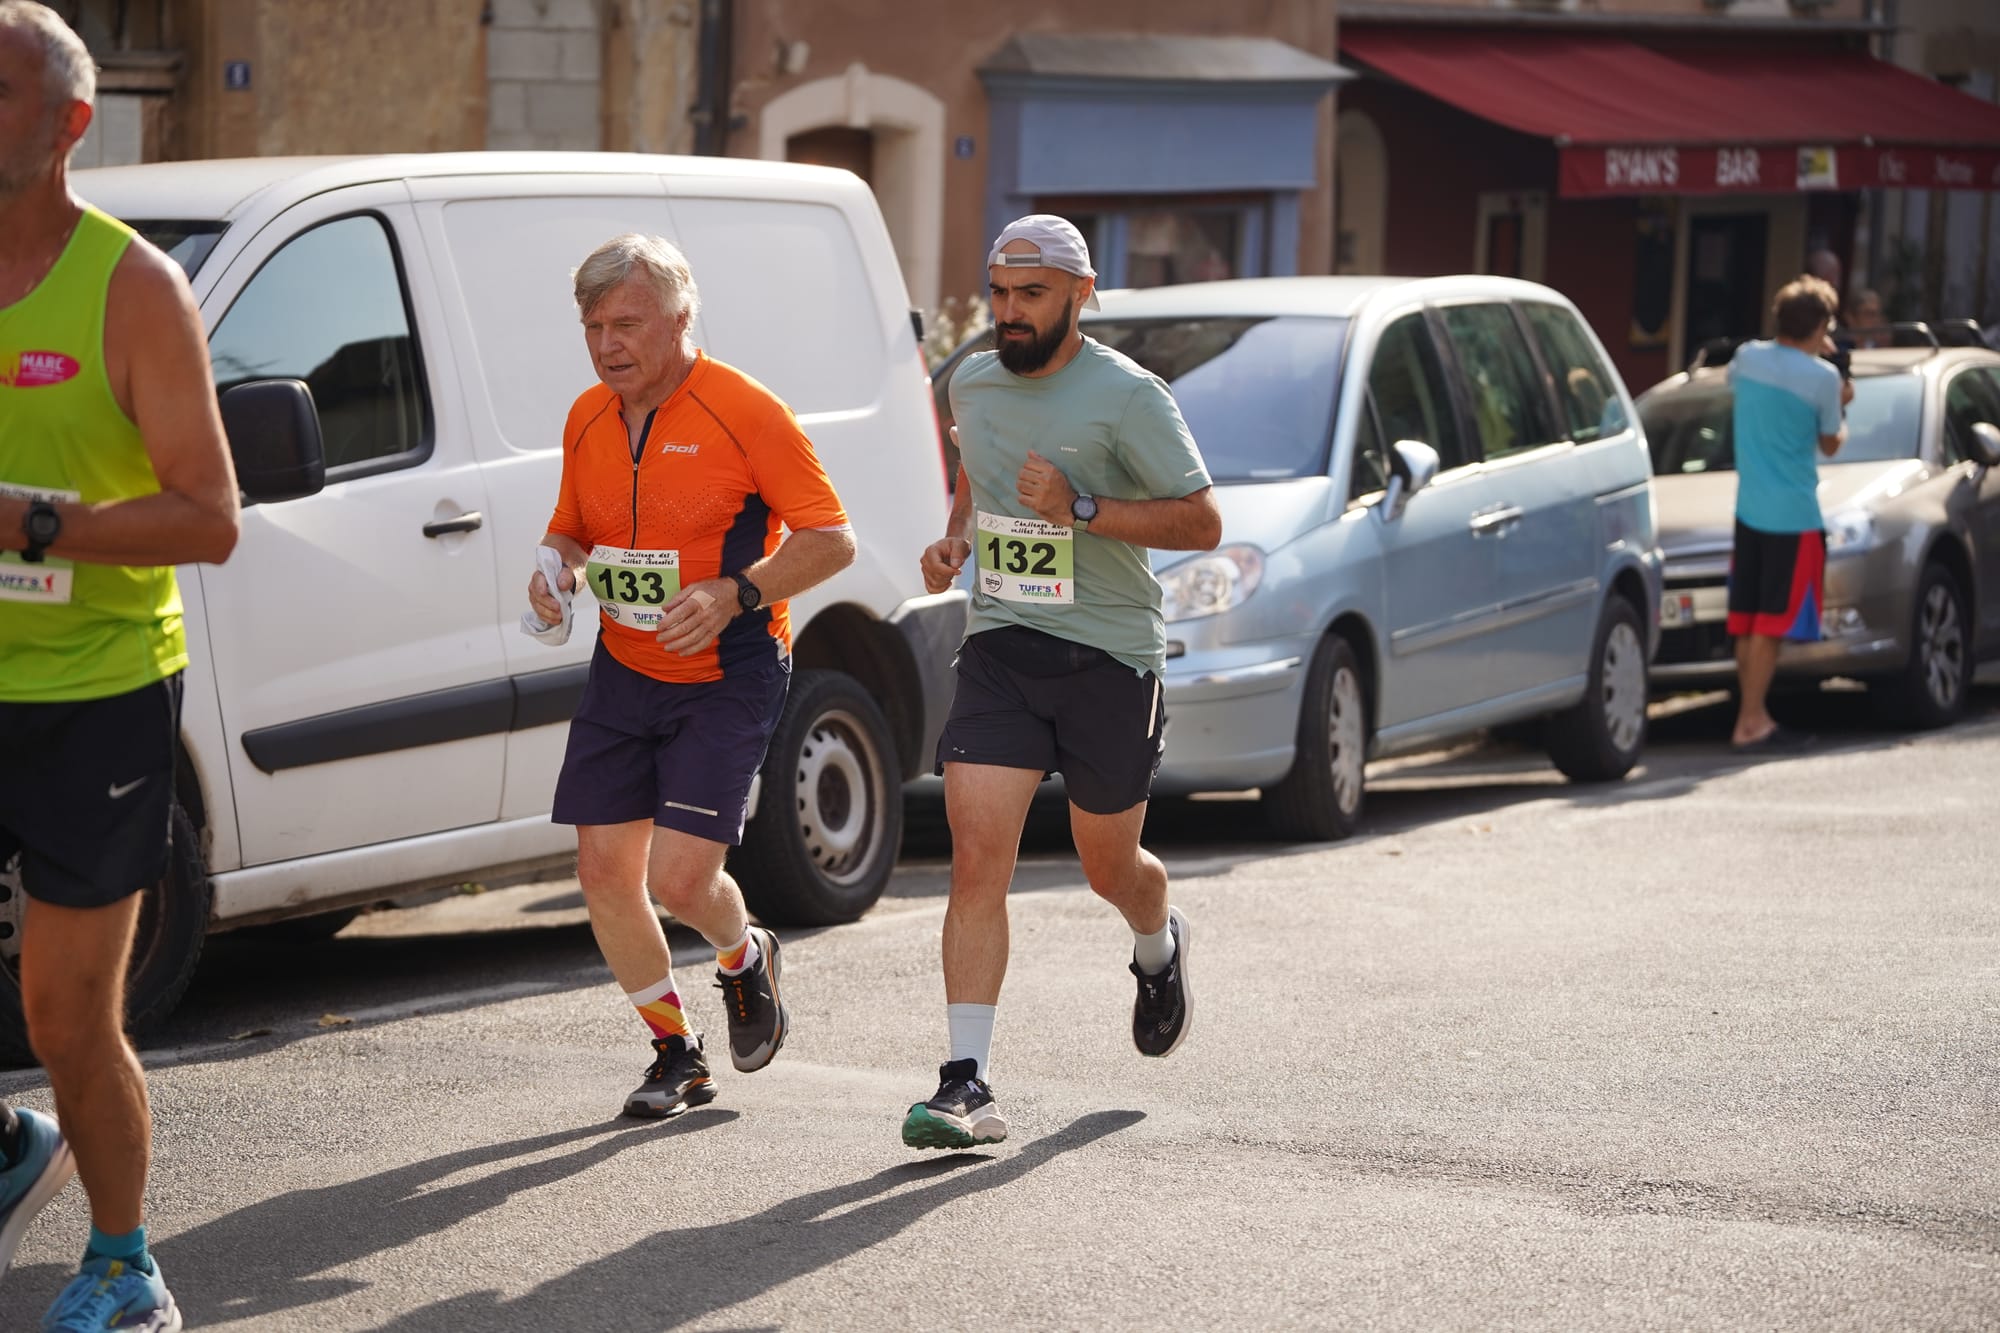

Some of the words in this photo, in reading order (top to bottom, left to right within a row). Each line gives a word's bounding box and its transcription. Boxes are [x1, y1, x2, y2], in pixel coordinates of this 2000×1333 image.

[1605, 148, 1679, 186] RYAN'S
[1716, 148, 1760, 185] BAR
[662, 444, 699, 454] poli
[1014, 520, 1048, 530] Challenge
[623, 551, 655, 560] Challenge
[988, 537, 1056, 575] 132
[0, 573, 39, 586] UFF'S
[598, 568, 665, 604] 133
[1019, 584, 1052, 593] TUFF'S
[633, 612, 663, 621] TUFF'S
